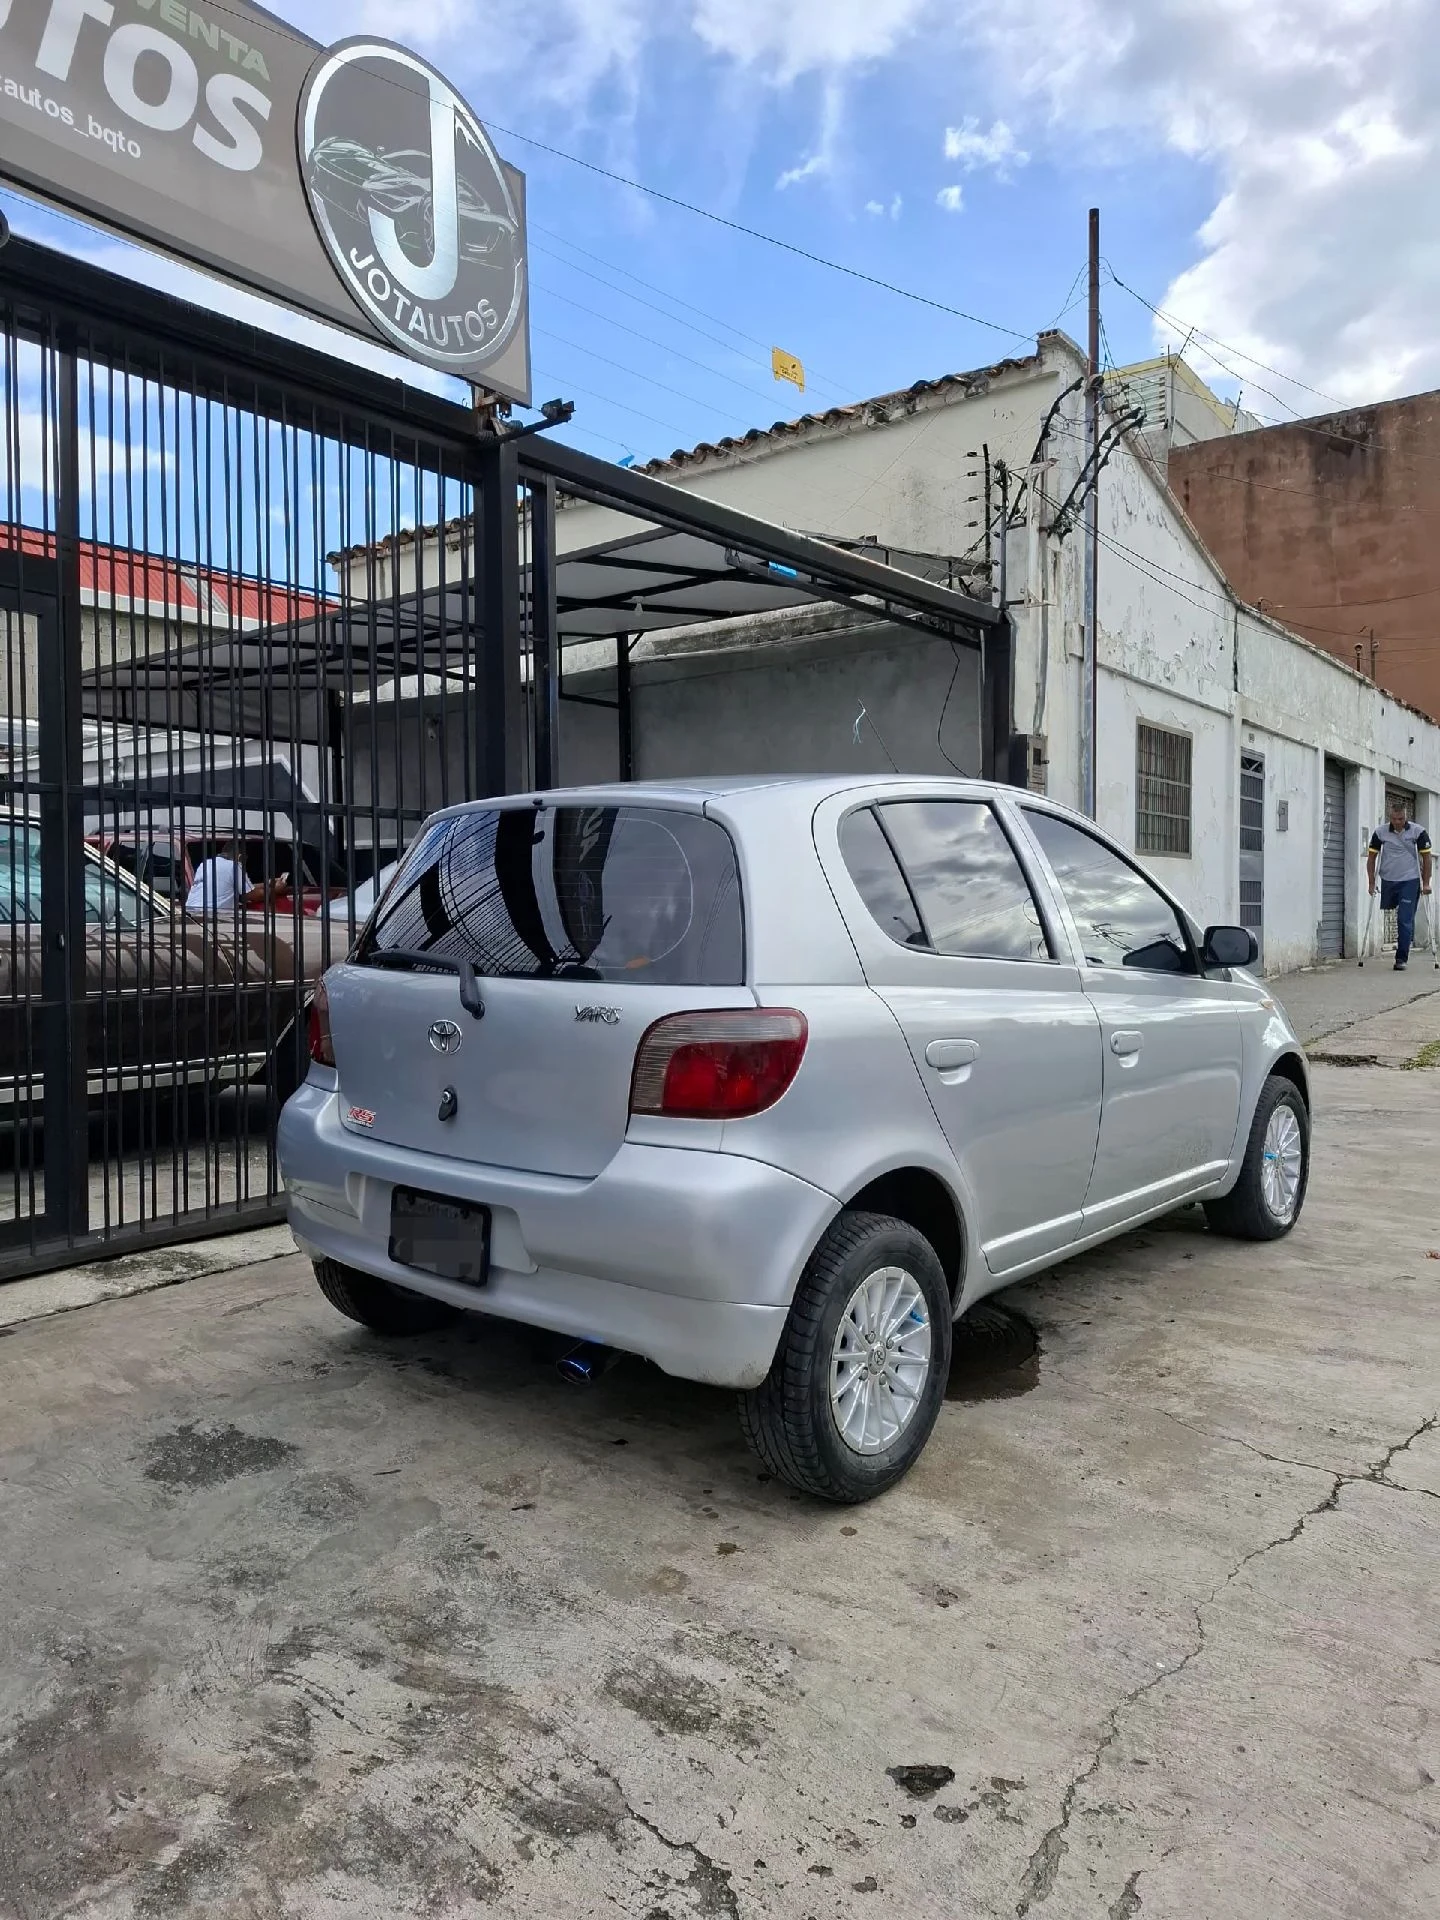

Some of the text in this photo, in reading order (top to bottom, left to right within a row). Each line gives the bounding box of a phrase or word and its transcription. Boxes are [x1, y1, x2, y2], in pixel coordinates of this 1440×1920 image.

[0, 0, 272, 171] TOS
[136, 0, 271, 82] ENTA
[350, 247, 498, 347] JOTAUTOS
[574, 1004, 622, 1025] YARIS
